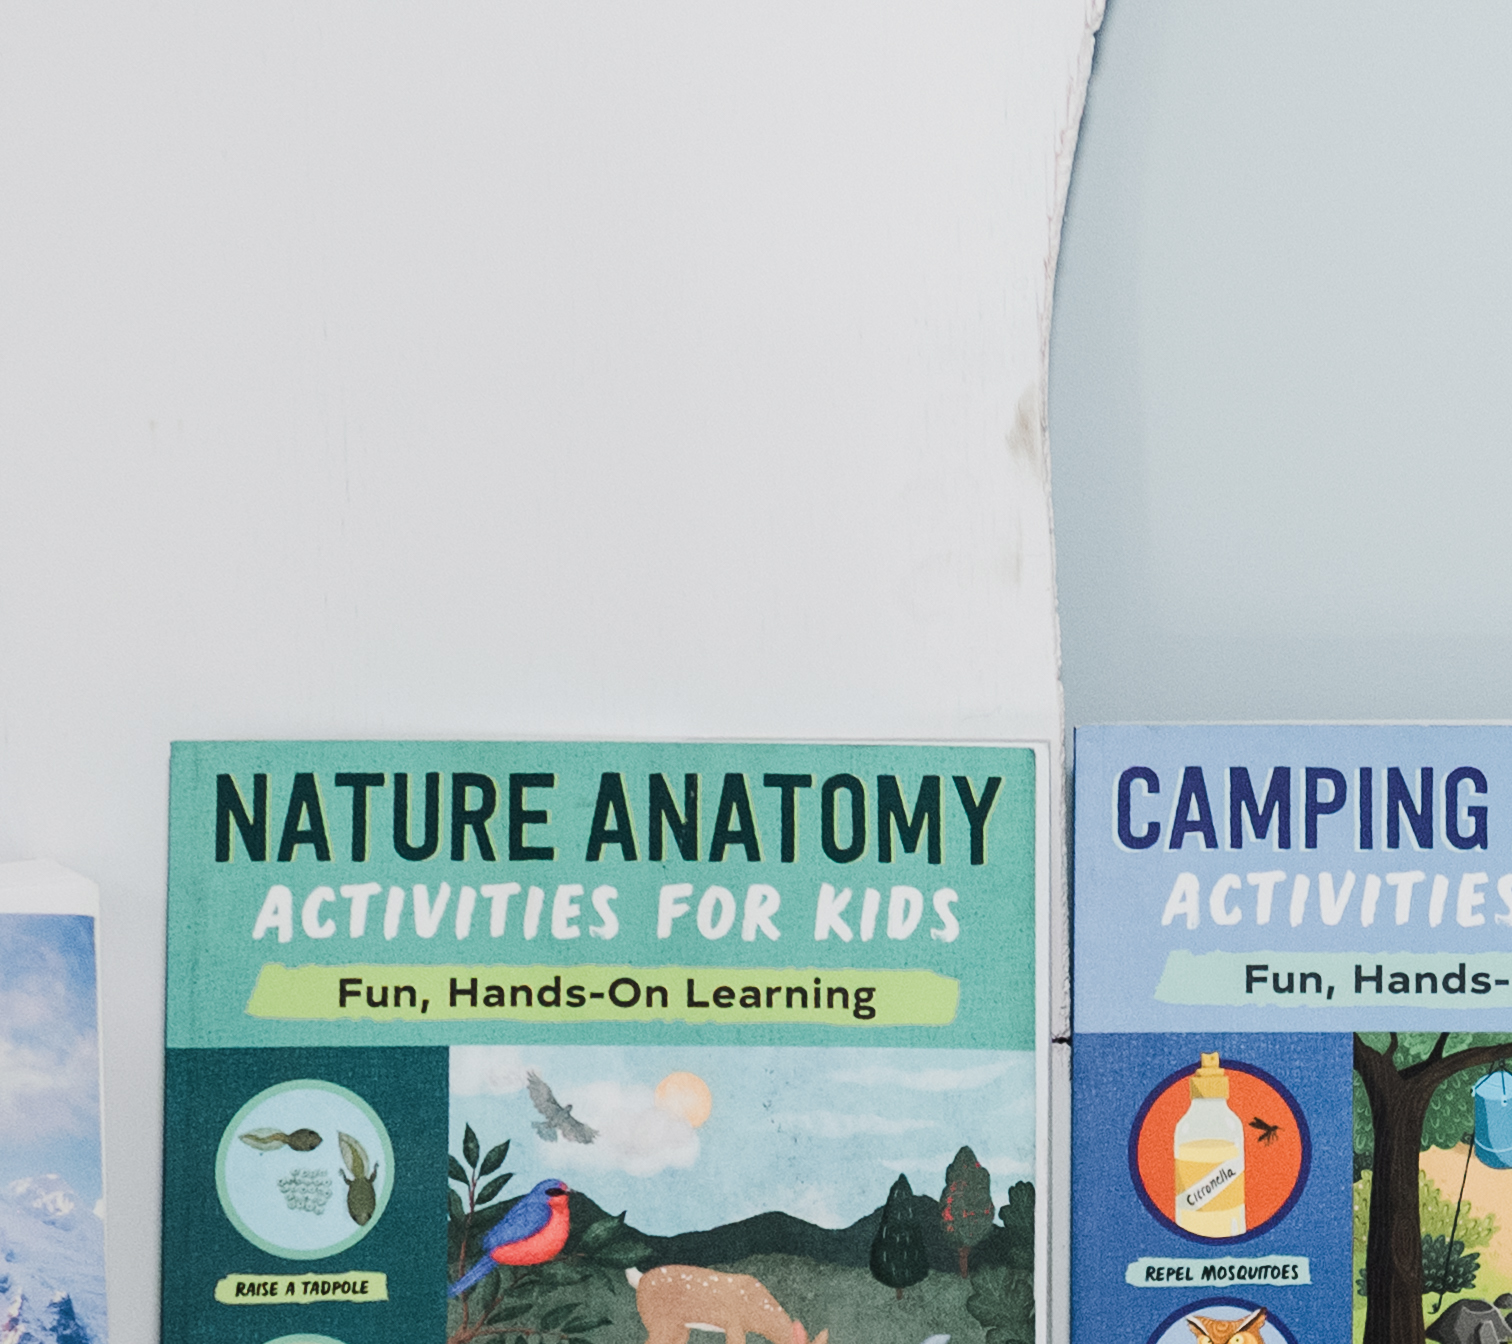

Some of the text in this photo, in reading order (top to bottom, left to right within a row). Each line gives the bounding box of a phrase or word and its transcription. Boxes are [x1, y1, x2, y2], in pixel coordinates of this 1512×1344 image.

[215, 772, 1003, 865] NATURE ANATOMY
[1116, 765, 1489, 851] CAMPING
[252, 882, 962, 944] ACTIVITIES FOR KIDS
[338, 977, 877, 1020] Fun, Hands-On Learning
[1244, 963, 1337, 1001] Fun,
[1186, 1168, 1236, 1206] Citronella
[235, 1280, 369, 1297] RAISE A TADPOLE
[1145, 1264, 1299, 1282] REPEL MOSQUITOES
